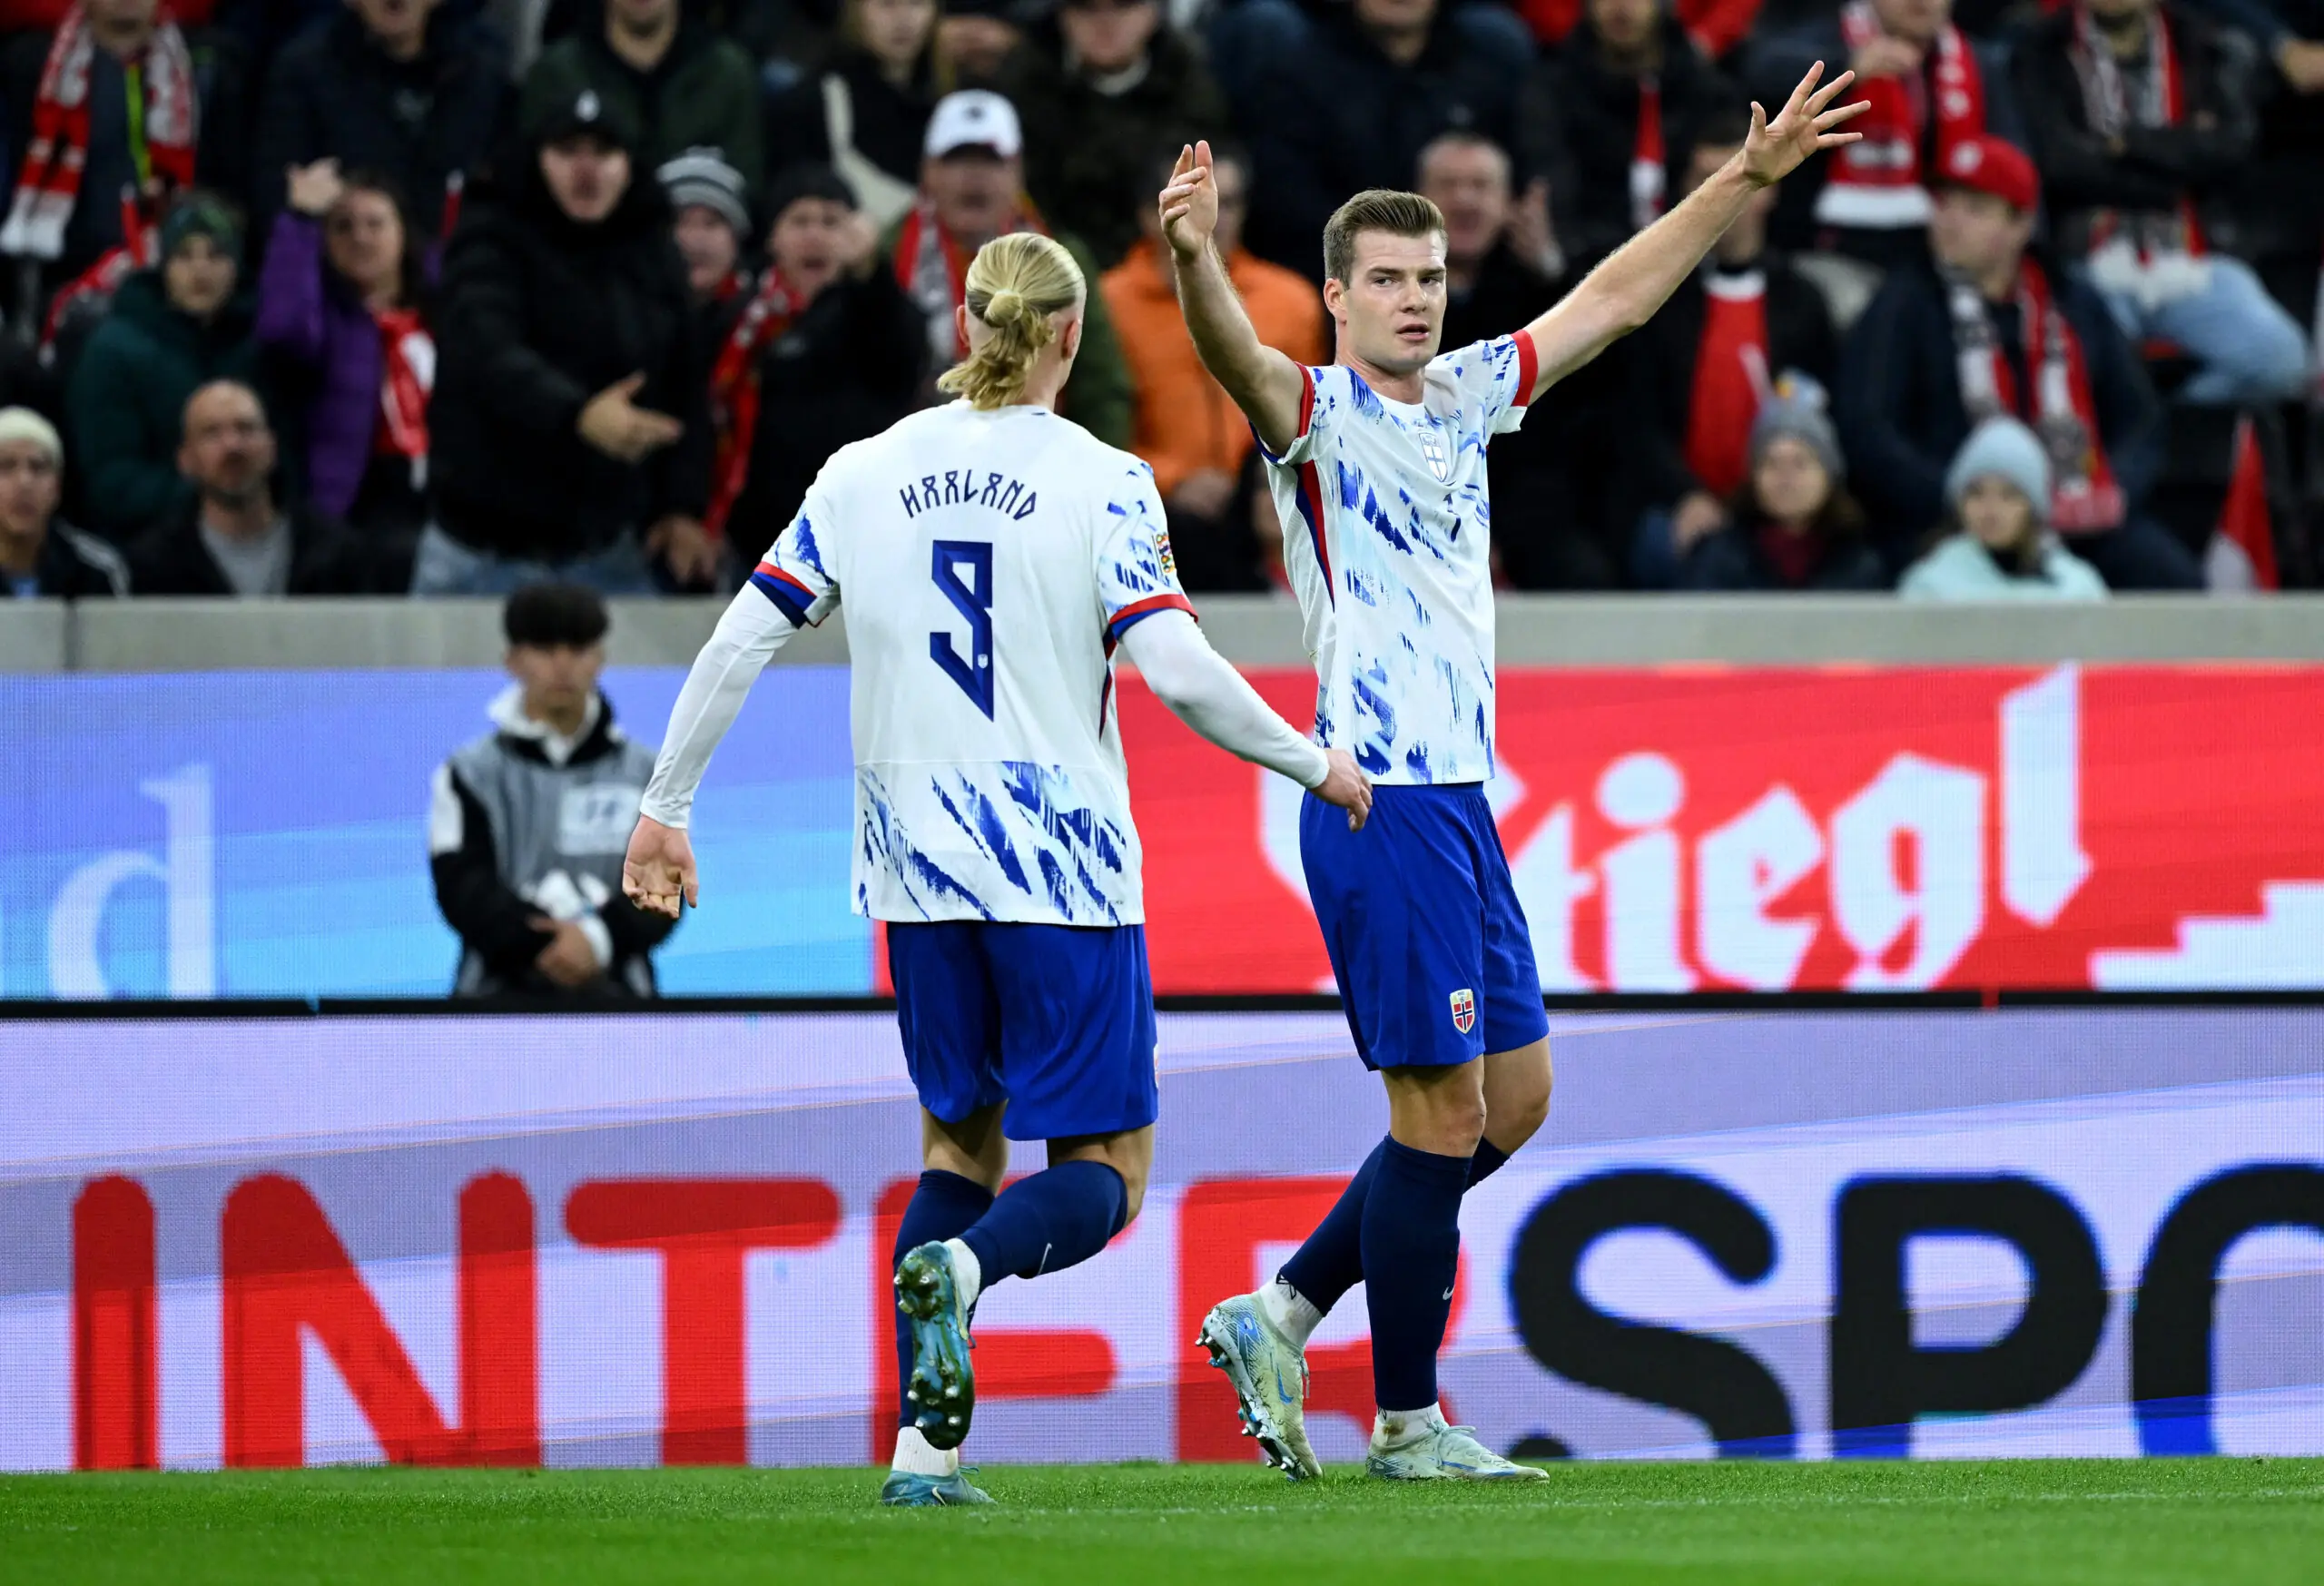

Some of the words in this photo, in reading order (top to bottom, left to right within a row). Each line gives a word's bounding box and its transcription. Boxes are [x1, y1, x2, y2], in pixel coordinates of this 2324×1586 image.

[900, 468, 1037, 520] HAALAND
[930, 539, 994, 723] 9
[1260, 659, 2091, 990] tiegl
